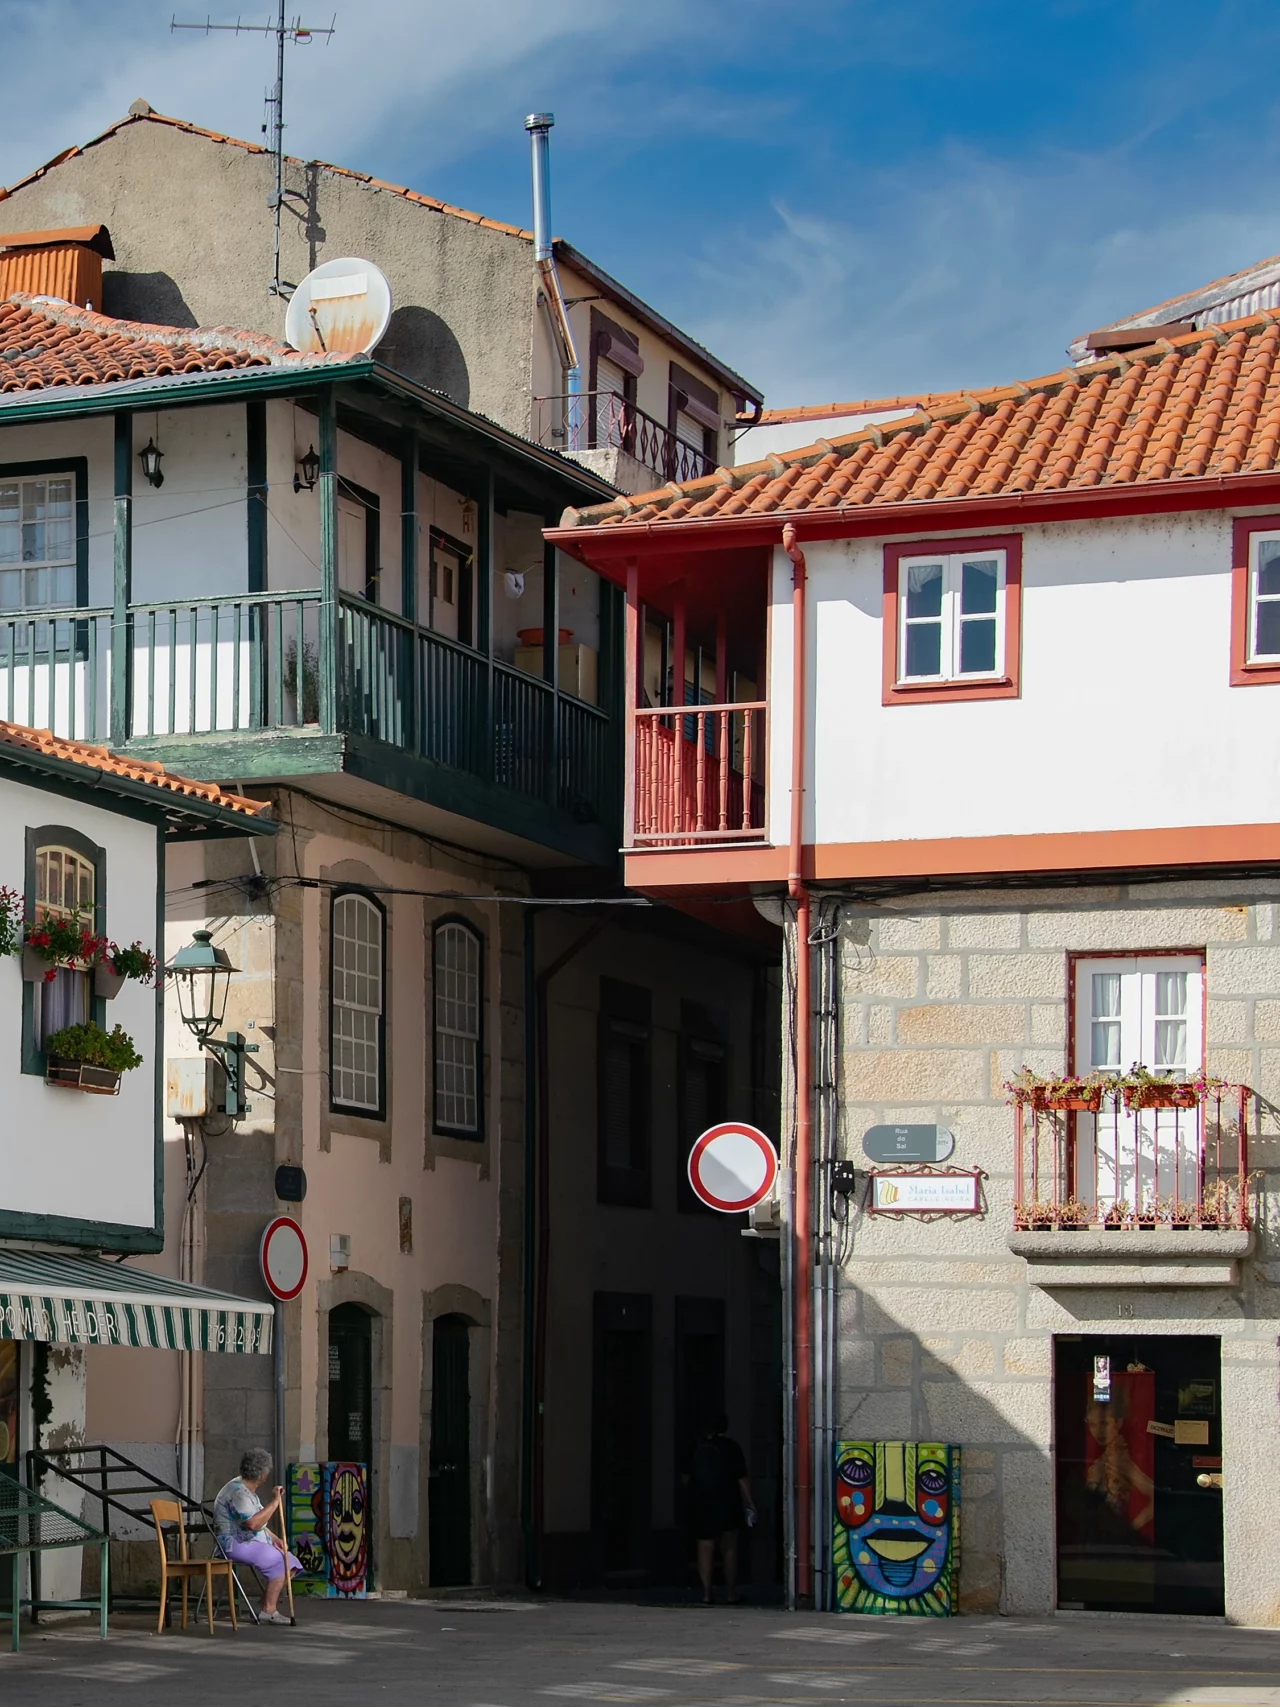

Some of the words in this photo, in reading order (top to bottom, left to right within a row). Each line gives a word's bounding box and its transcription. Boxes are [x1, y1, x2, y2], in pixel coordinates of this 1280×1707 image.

[908, 1186, 937, 1195] Maria
[941, 1184, 970, 1195] Isabel
[63, 1309, 118, 1338] HÉLDER
